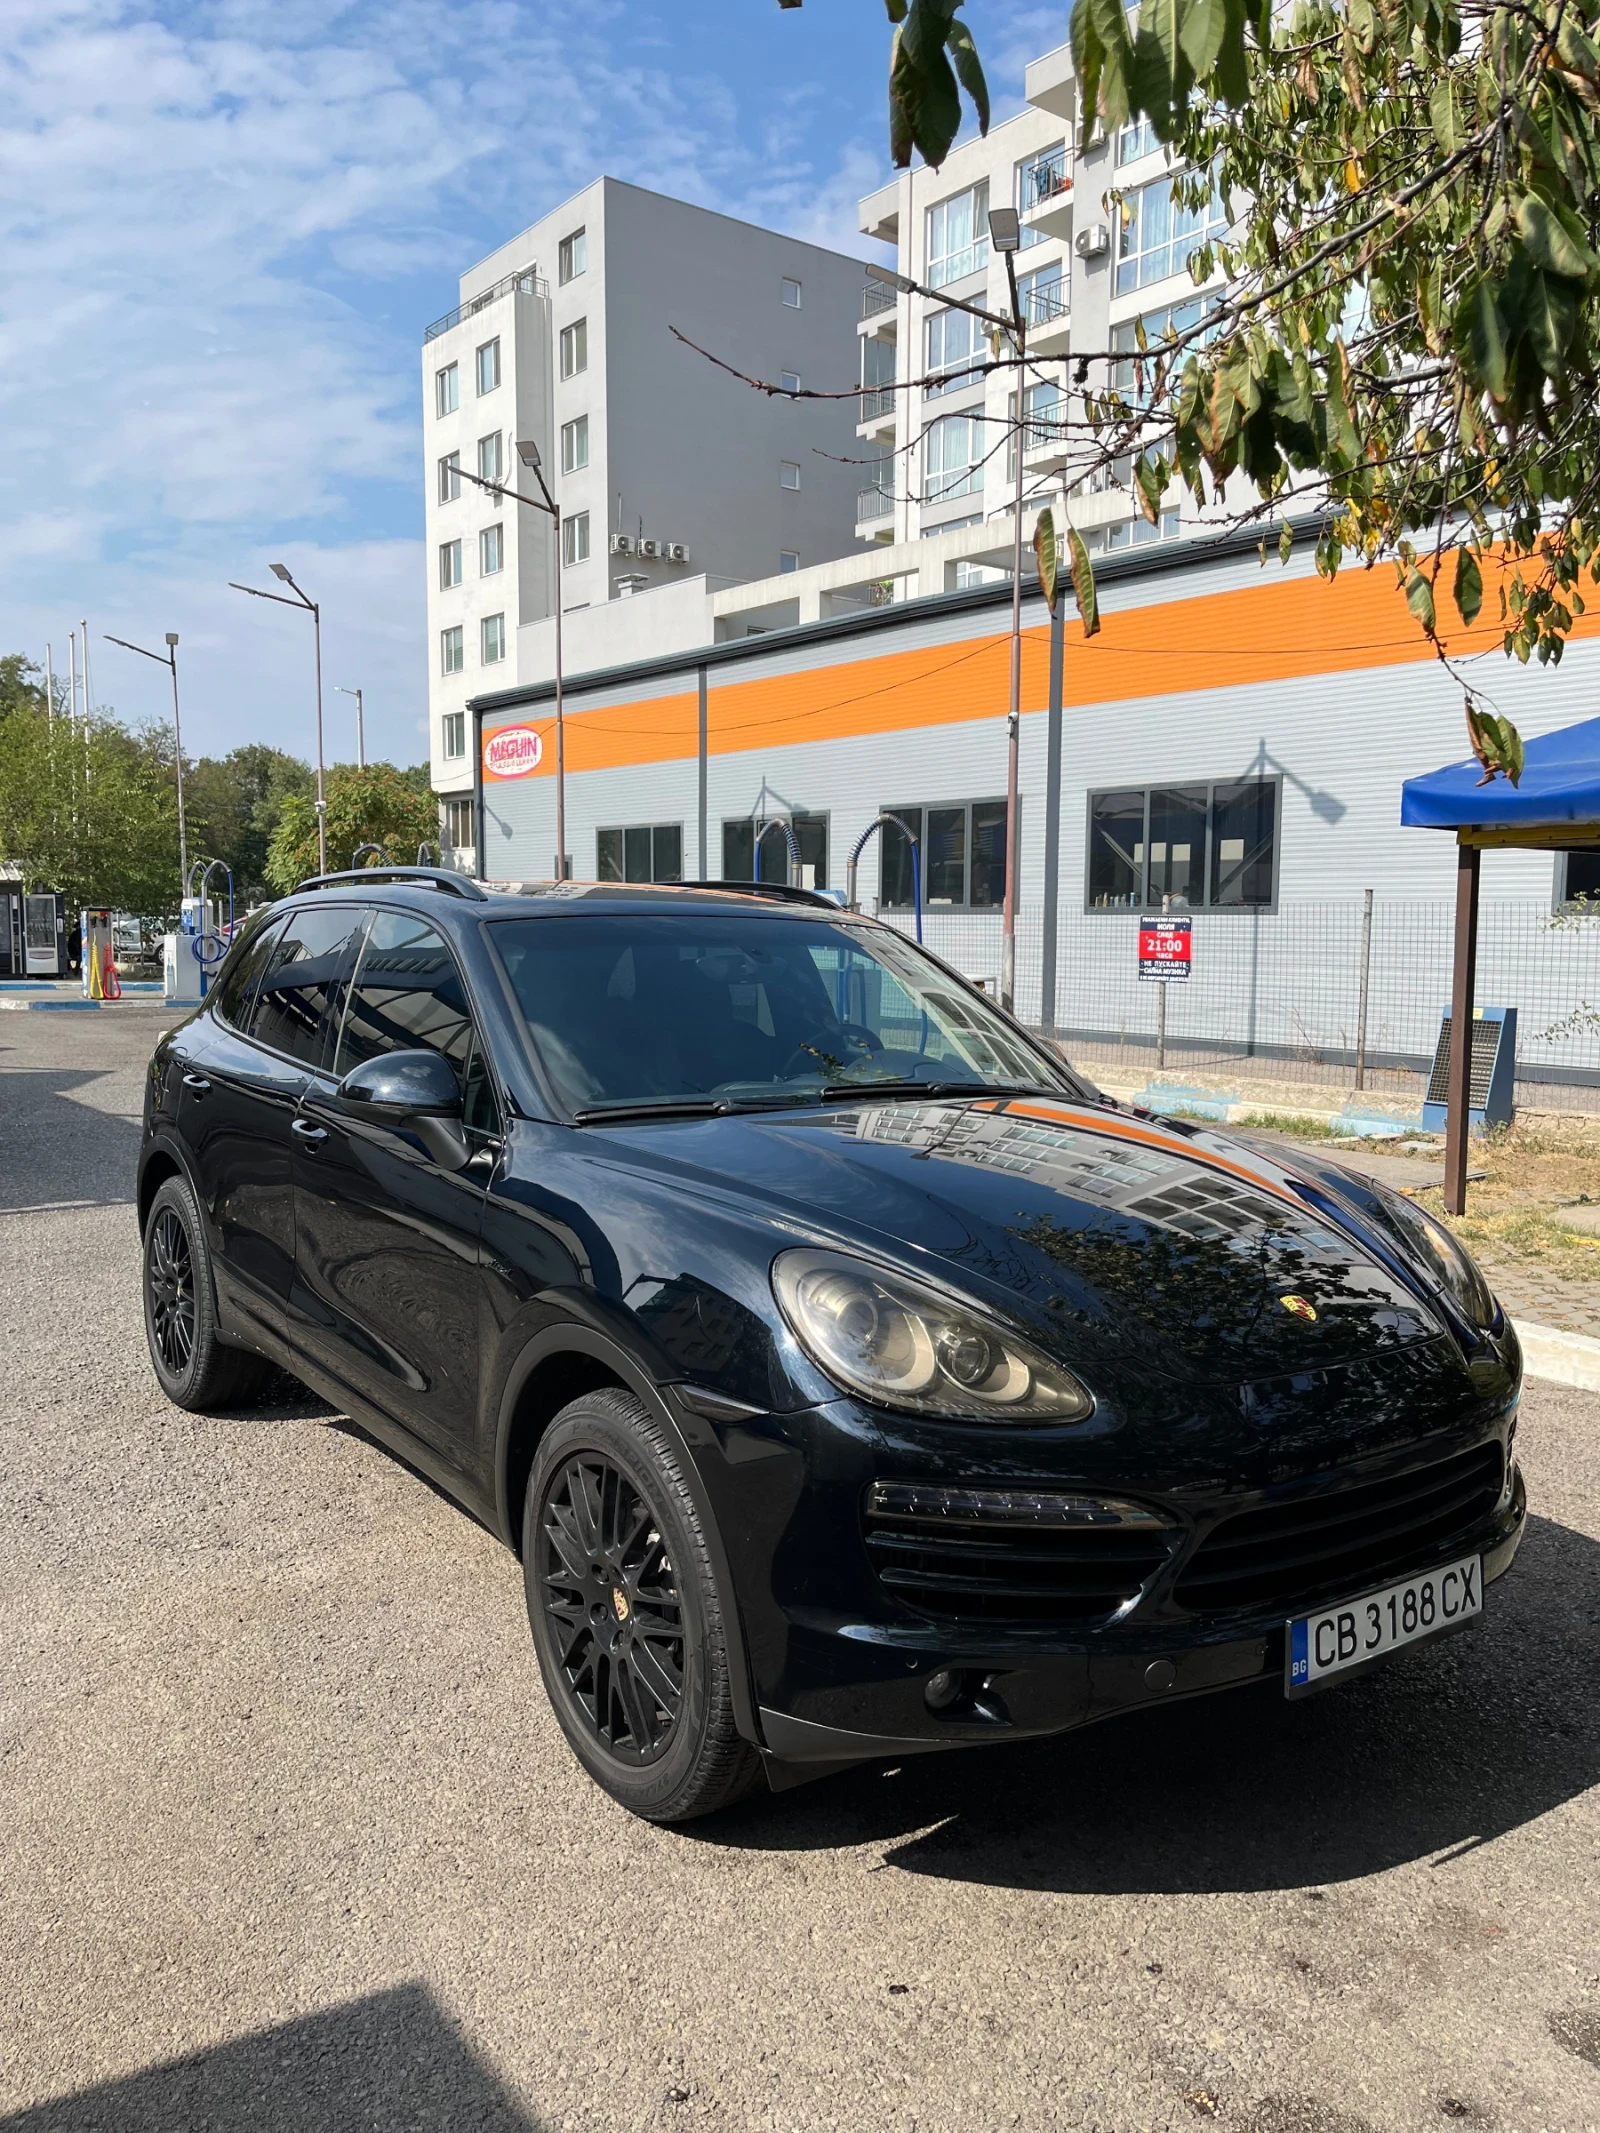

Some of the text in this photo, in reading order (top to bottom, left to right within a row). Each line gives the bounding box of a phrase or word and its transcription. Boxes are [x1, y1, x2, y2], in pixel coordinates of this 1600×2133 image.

[490, 737, 537, 761] MEGUIN
[1147, 939, 1182, 952] 21:00
[1154, 960, 1187, 968] ПУСКАЙТЕ
[1365, 1581, 1436, 1650] 3188
[1291, 1659, 1307, 1677] BG
